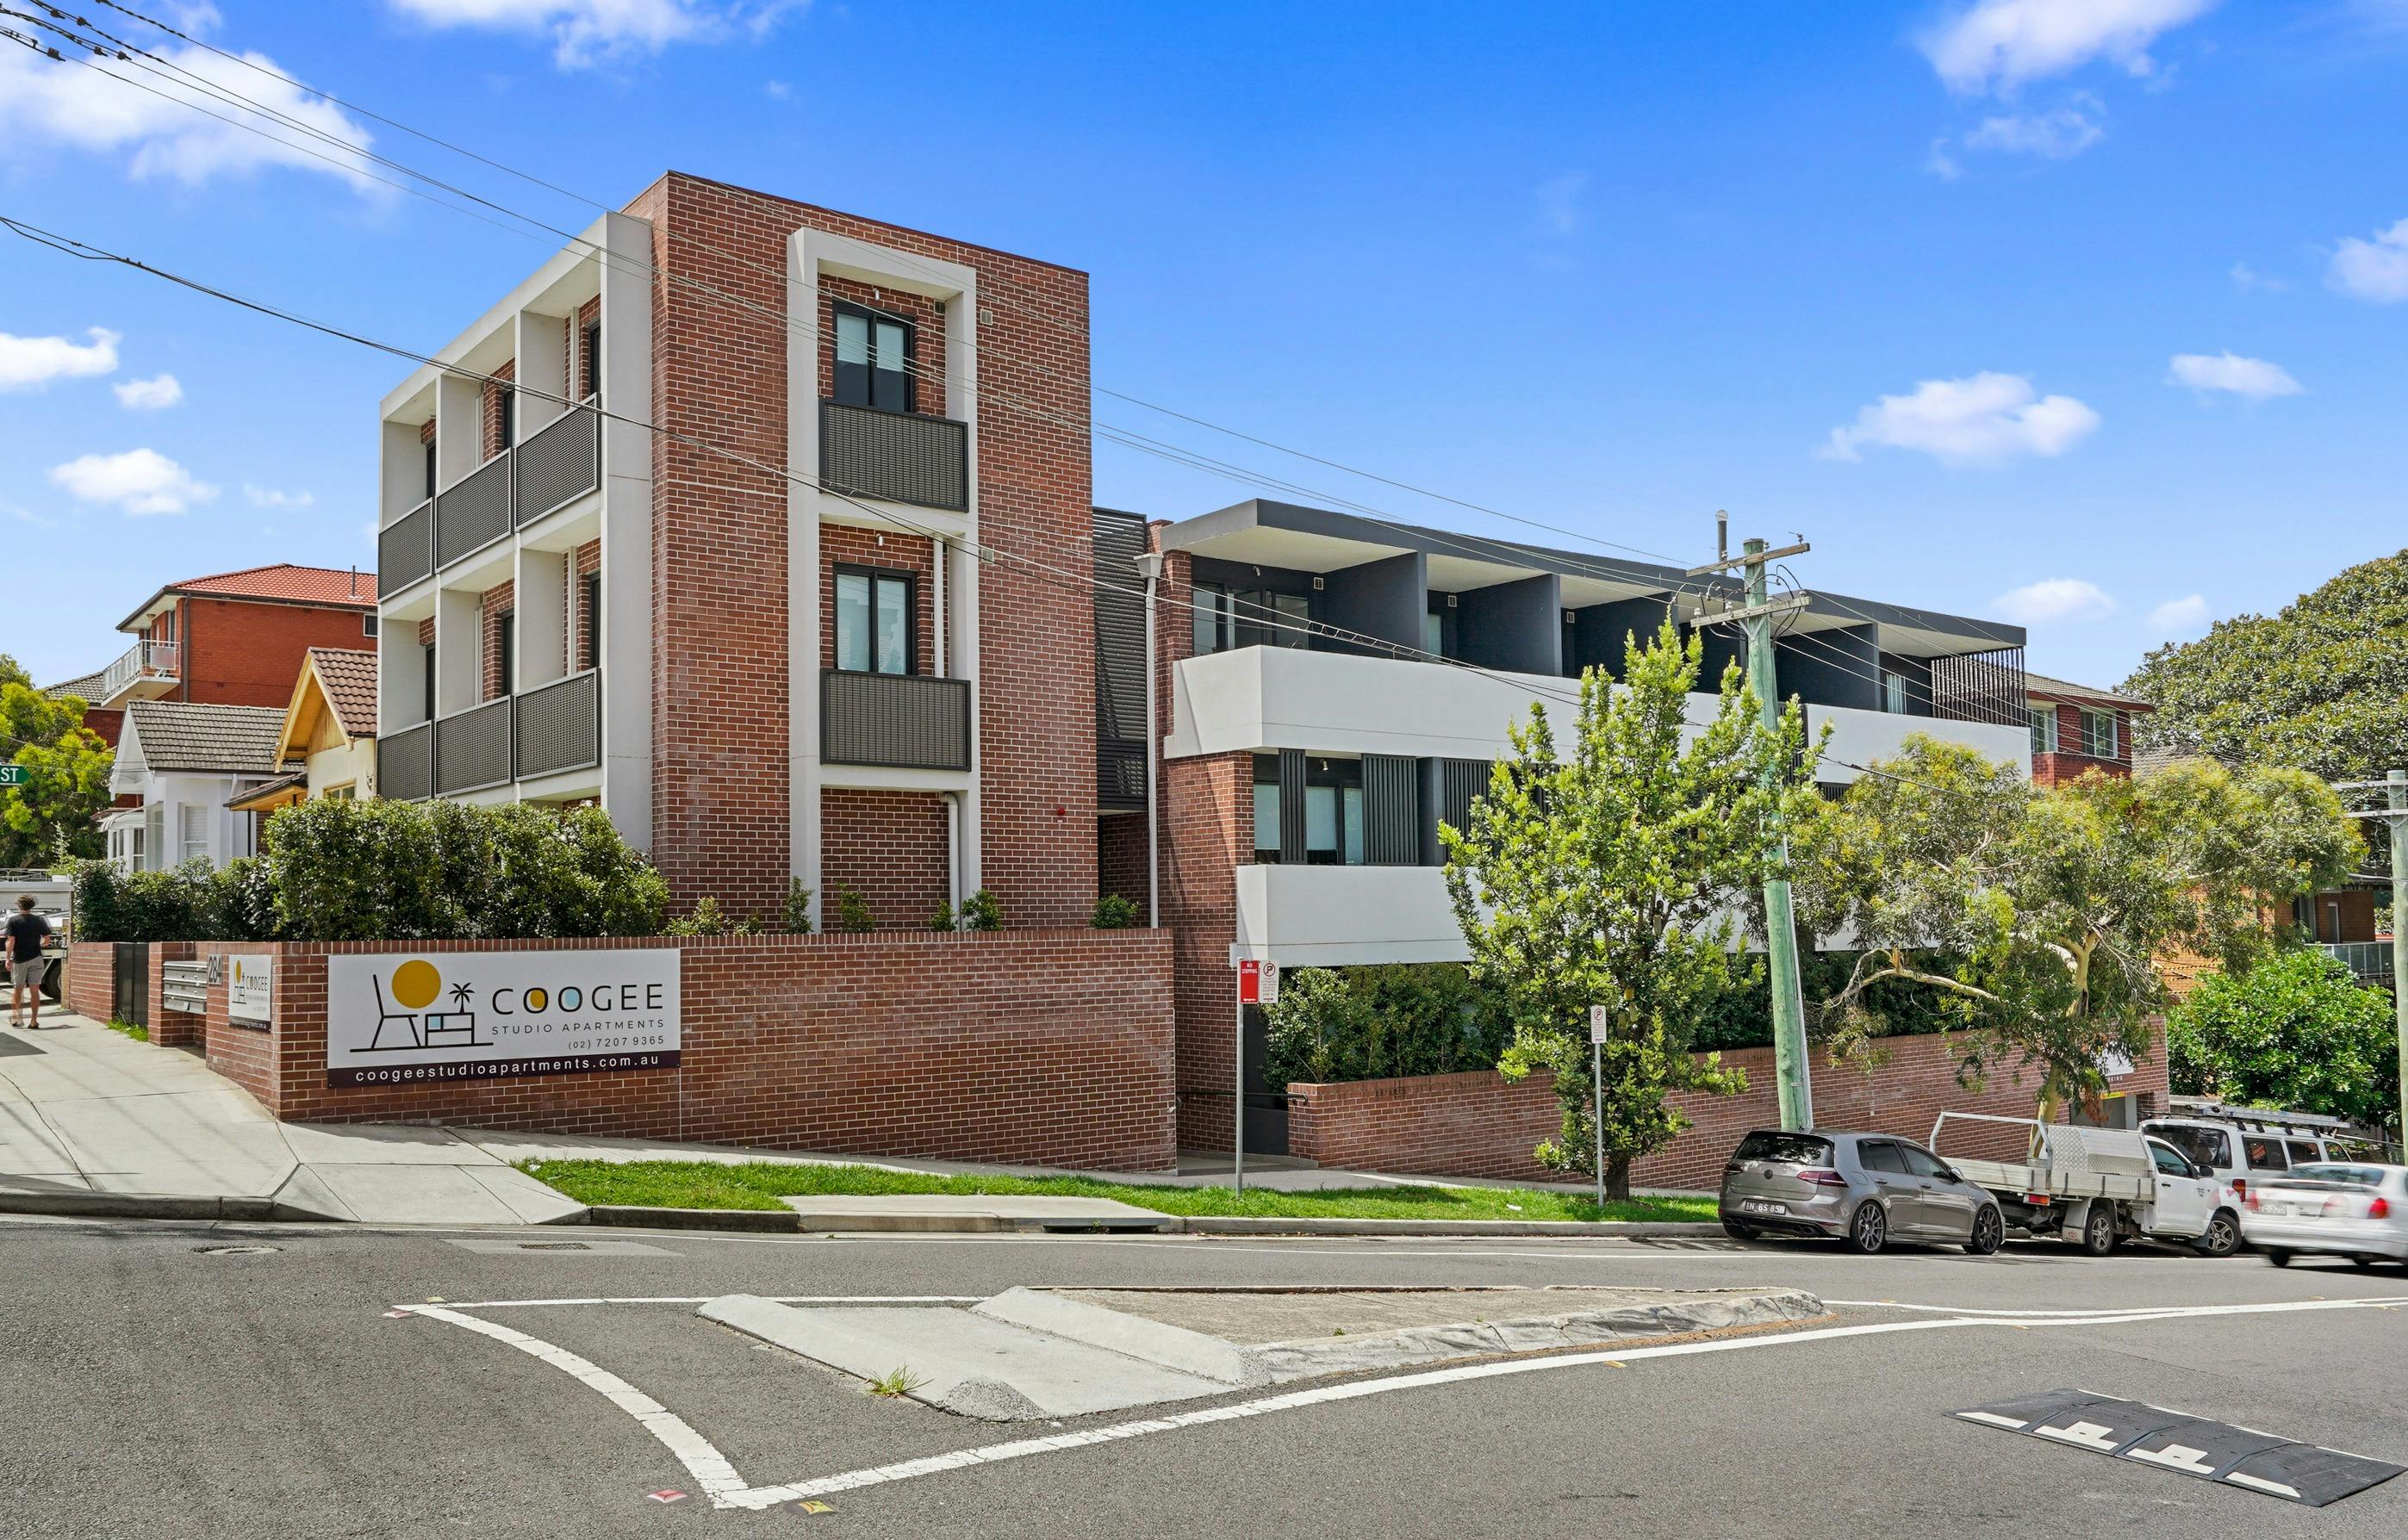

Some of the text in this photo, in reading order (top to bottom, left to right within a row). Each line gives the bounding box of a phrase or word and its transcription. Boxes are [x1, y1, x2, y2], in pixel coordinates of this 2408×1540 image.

[1, 767, 19, 782] ST
[208, 956, 221, 984] 284
[492, 984, 663, 1015] COOGEE
[492, 1019, 664, 1034] STUDIO APARTMENTS
[568, 1035, 664, 1050] (02) 7207 9365
[356, 1054, 658, 1082] coogeestudioapartments.com.au
